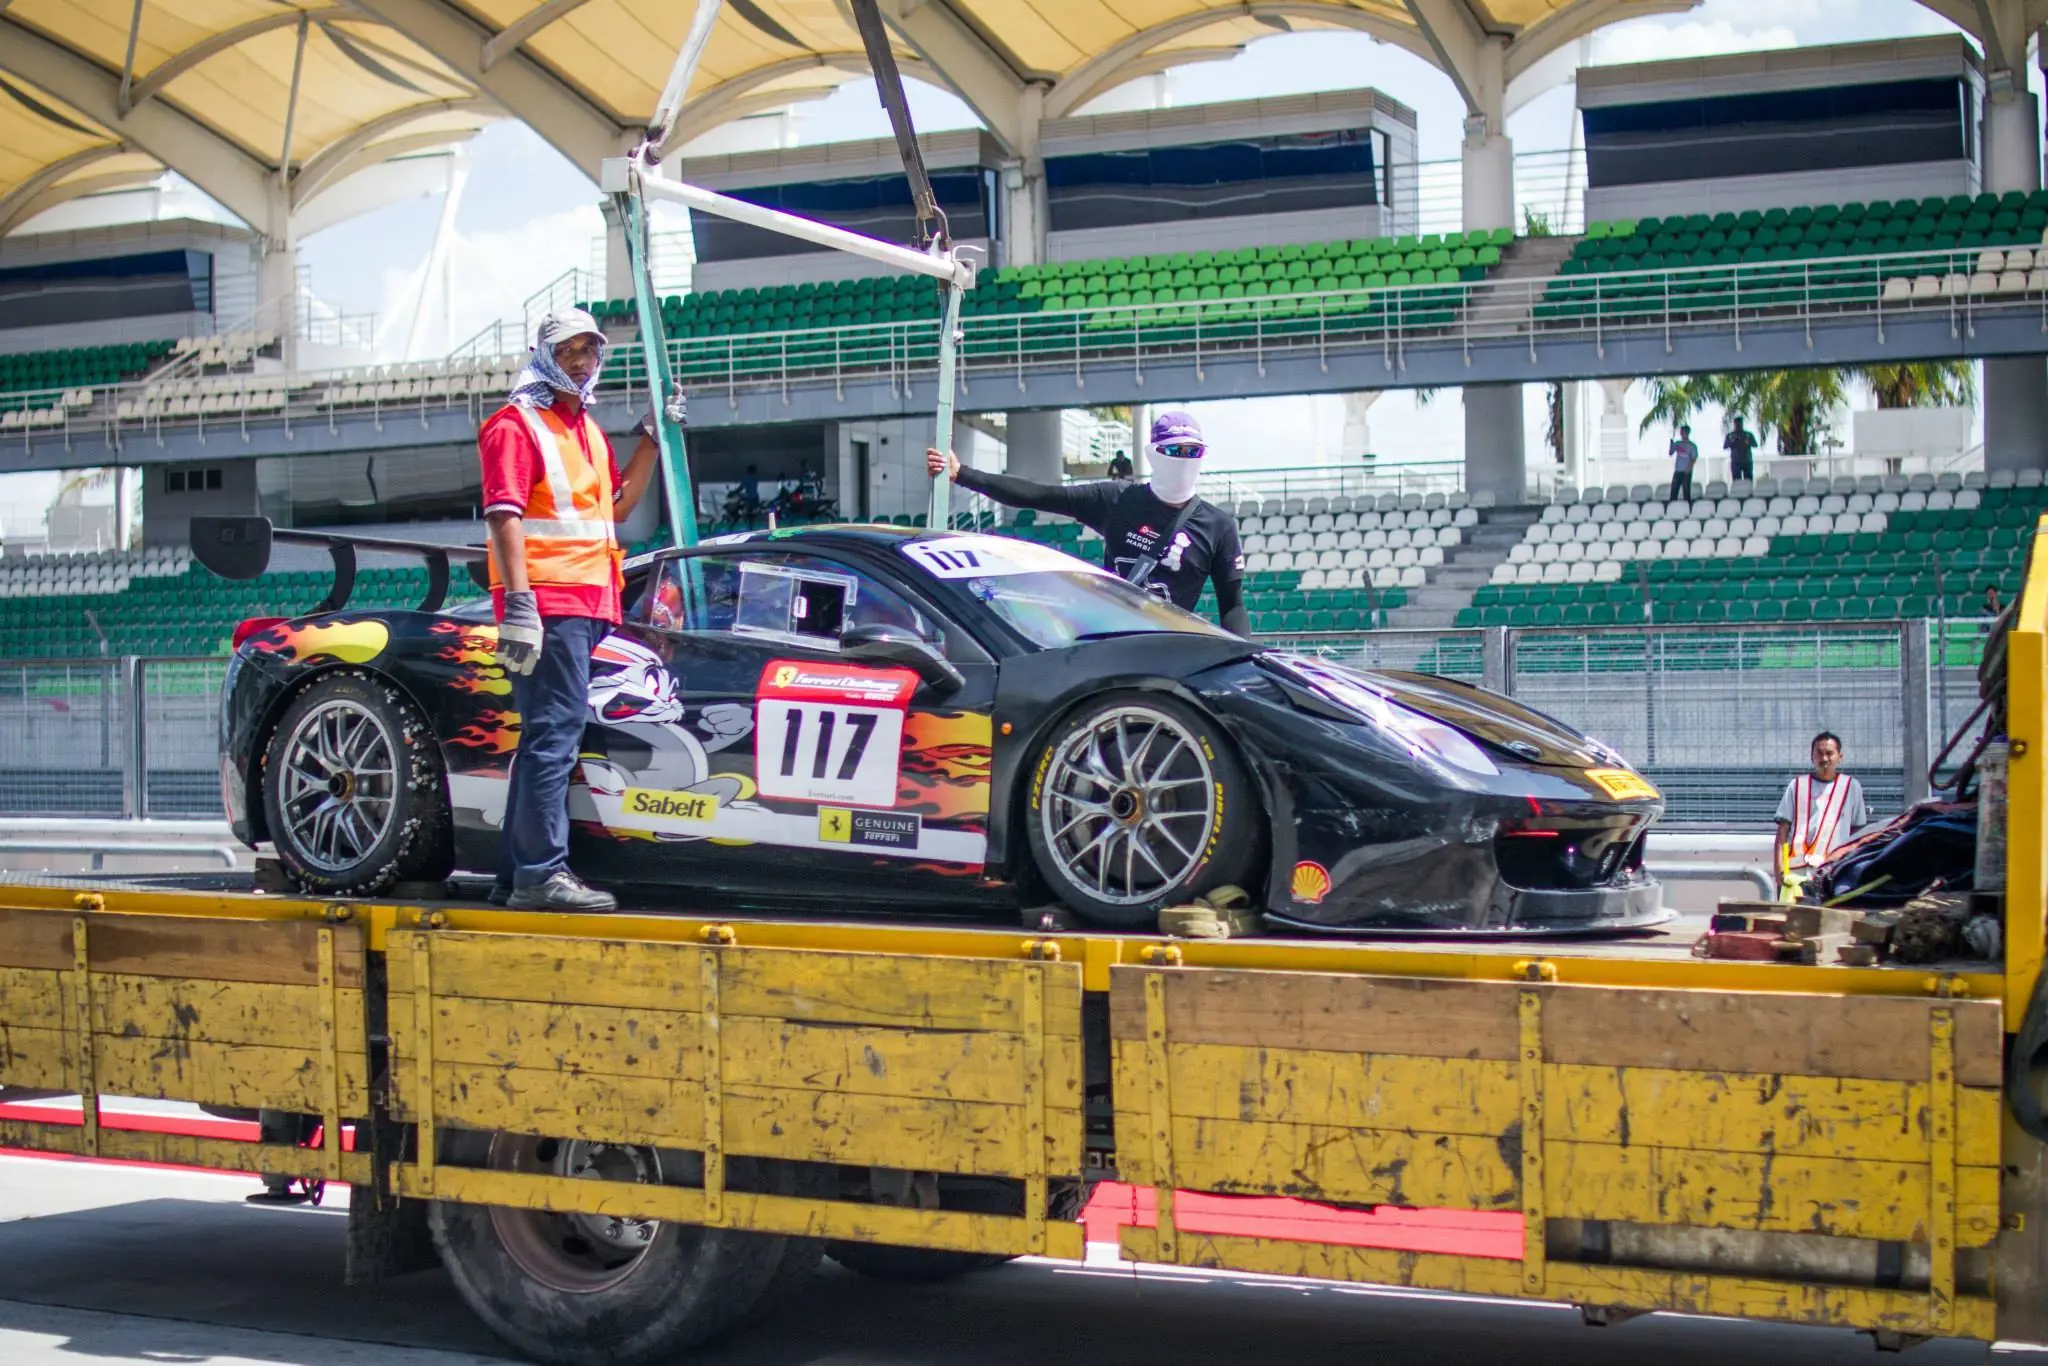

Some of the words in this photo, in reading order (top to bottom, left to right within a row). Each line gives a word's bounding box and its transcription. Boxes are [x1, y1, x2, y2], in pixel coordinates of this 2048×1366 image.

[922, 549, 980, 571] 117
[780, 708, 878, 780] 117
[633, 792, 706, 818] Sabelt
[855, 818, 914, 832] GENUINE
[864, 831, 900, 842] Ferrari
